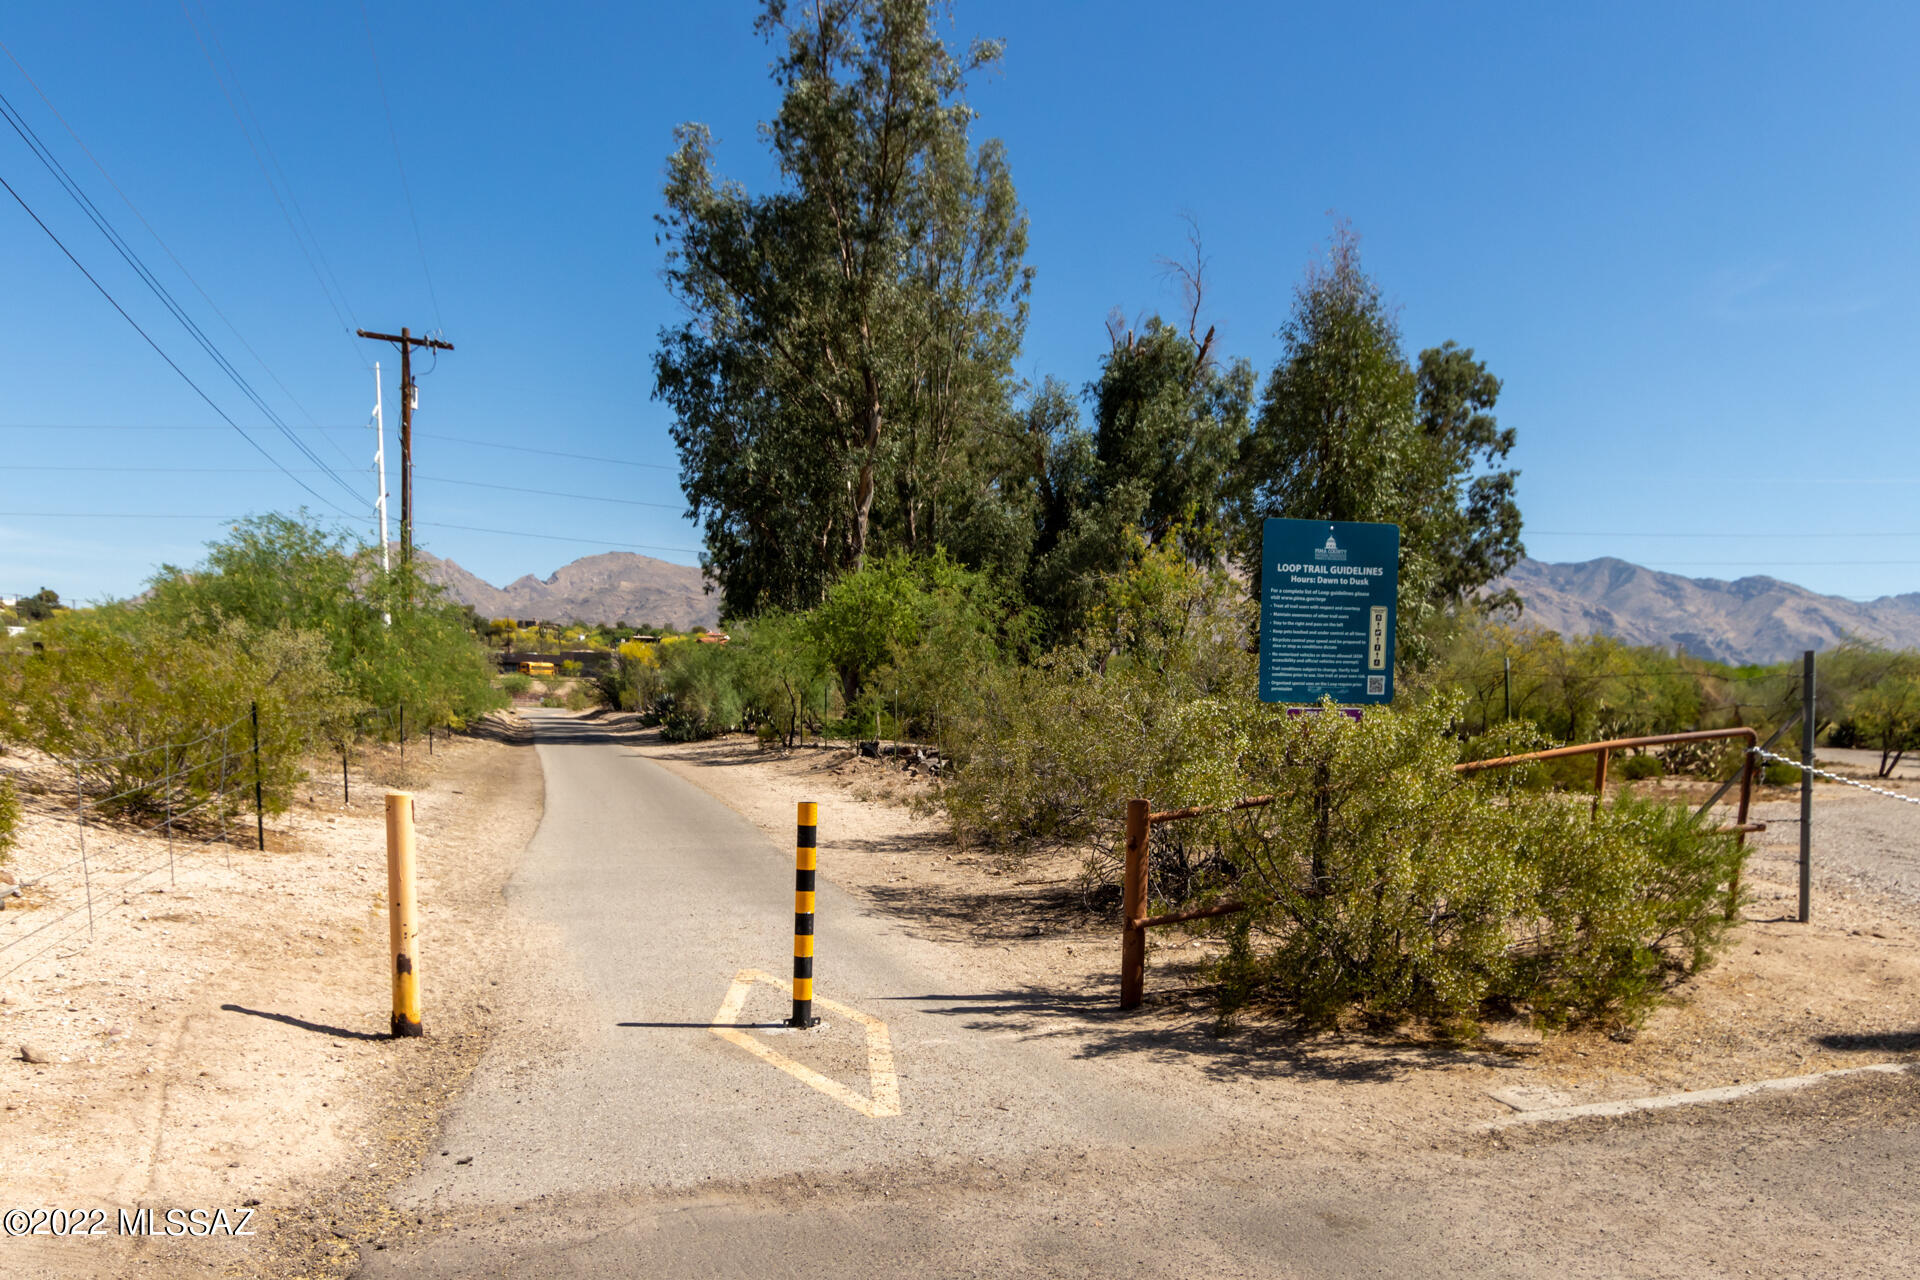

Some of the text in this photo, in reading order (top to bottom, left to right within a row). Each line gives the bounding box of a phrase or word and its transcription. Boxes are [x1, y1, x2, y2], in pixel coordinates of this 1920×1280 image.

[1277, 563, 1383, 576] LOOP TRAIL GUIDELINES
[1291, 575, 1315, 583] Hours:
[1317, 576, 1338, 584] Dawn
[1350, 577, 1369, 585] Dusk
